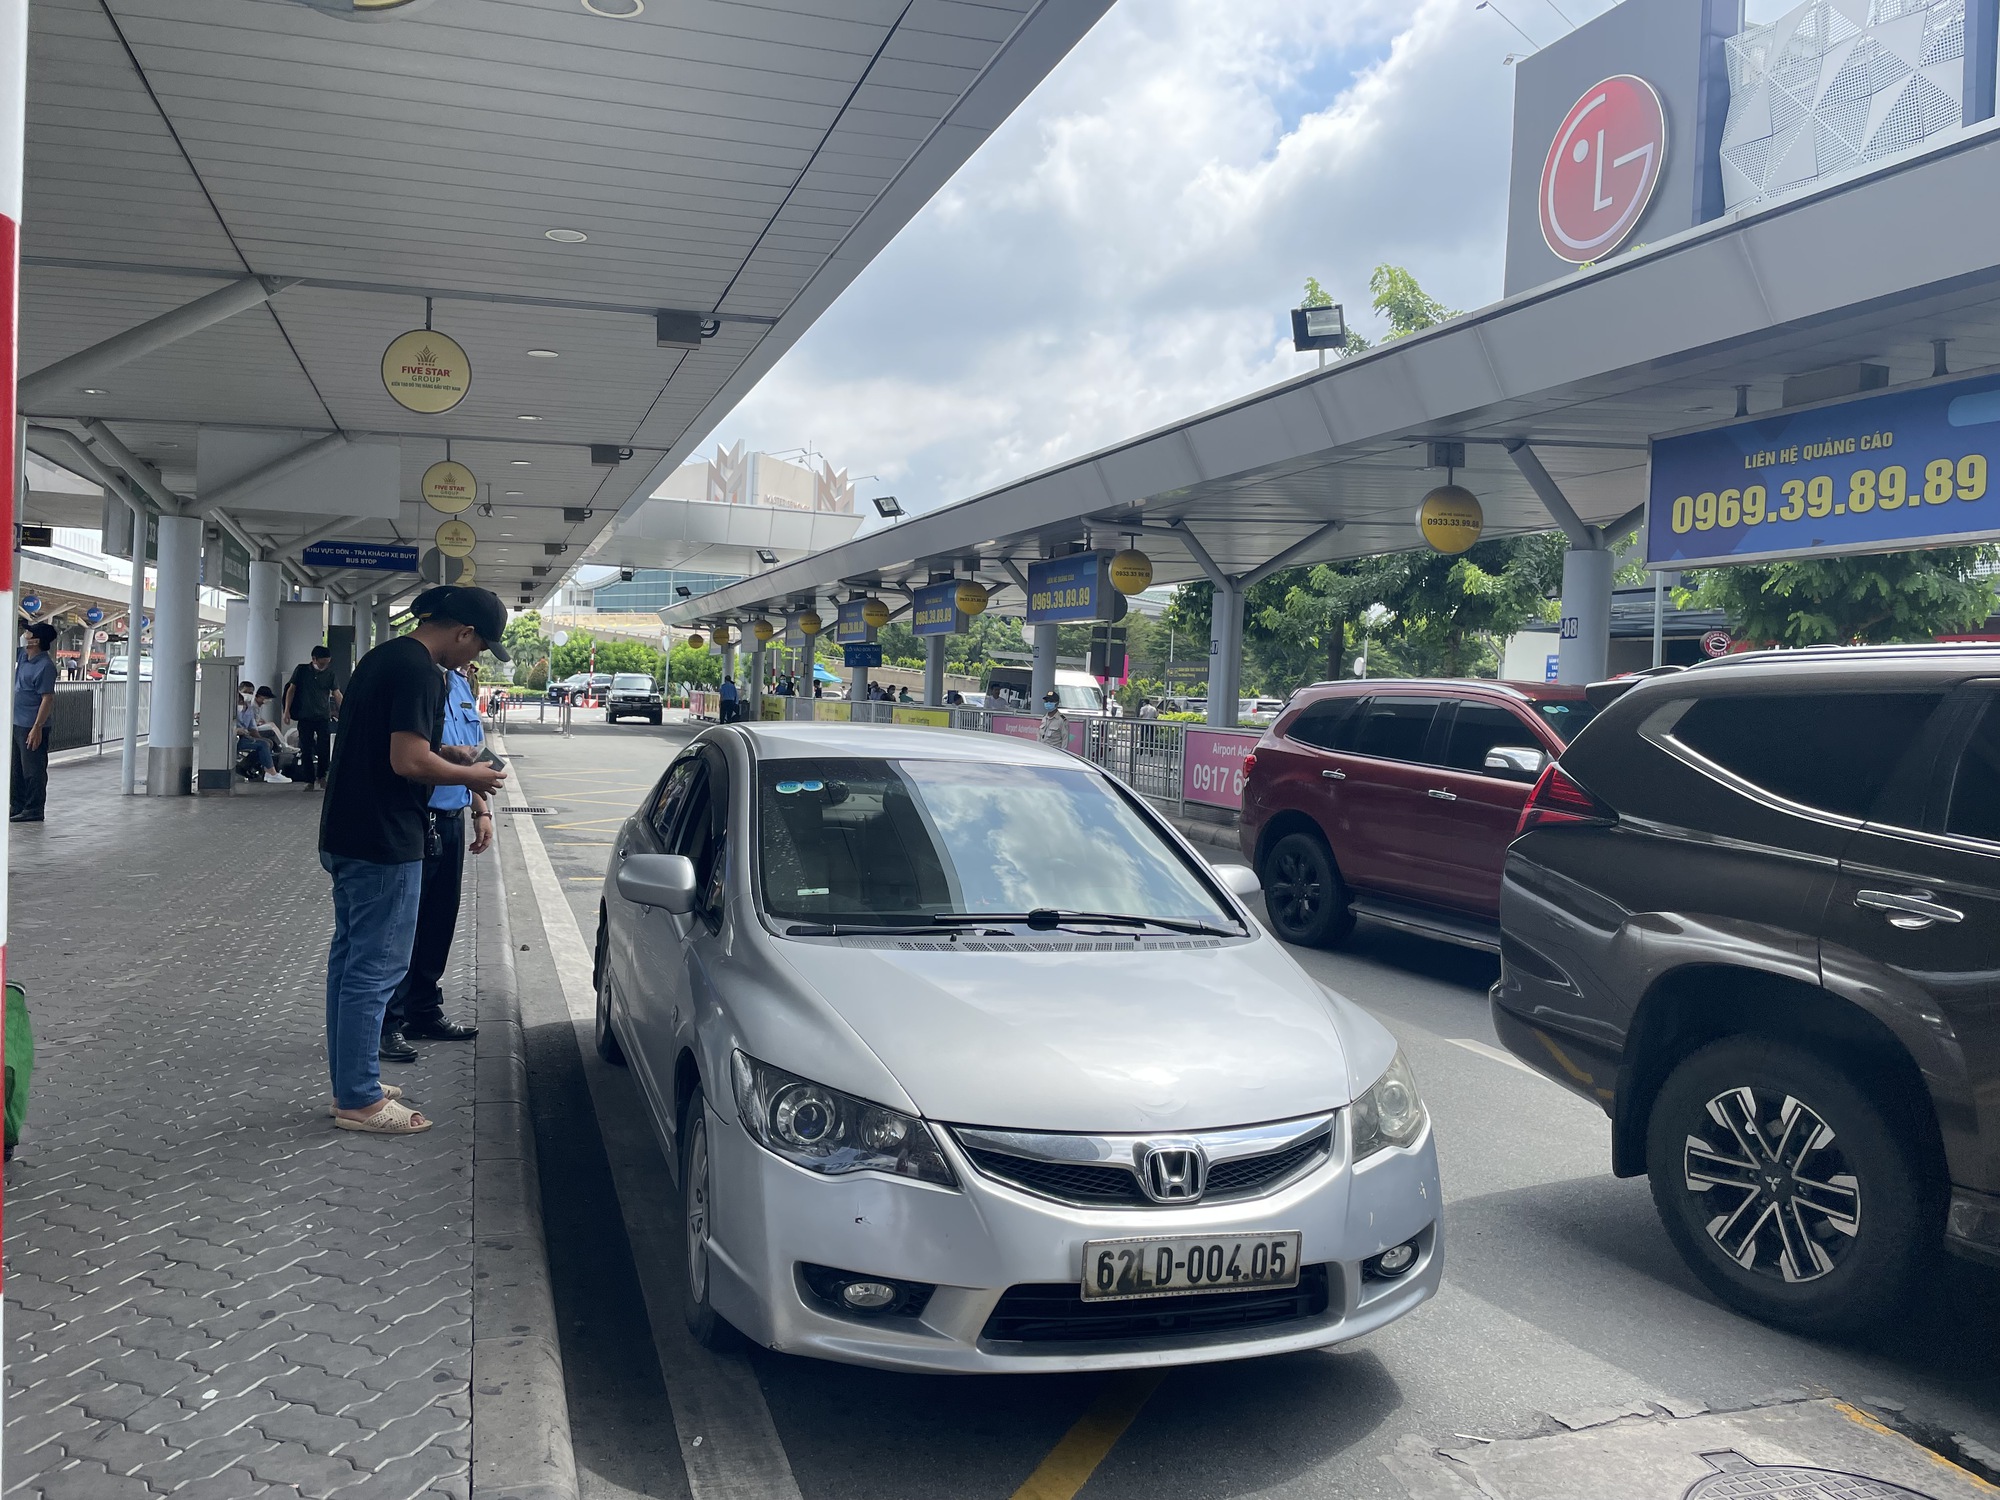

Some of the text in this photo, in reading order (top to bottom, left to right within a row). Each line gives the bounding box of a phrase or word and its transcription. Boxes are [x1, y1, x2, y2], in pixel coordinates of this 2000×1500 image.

[401, 366, 451, 378] FIVE STAR
[411, 374, 442, 384] GROUP
[1744, 430, 1894, 470] LIÊN HỆ QUẢNG CÁO
[1670, 453, 1989, 535] 0969.39.89.89
[1032, 586, 1090, 611] 0969.39.89.89
[1212, 742, 1236, 758] Airport
[1192, 763, 1230, 793] 0917
[1096, 1240, 1289, 1292] 62LD-004.05
